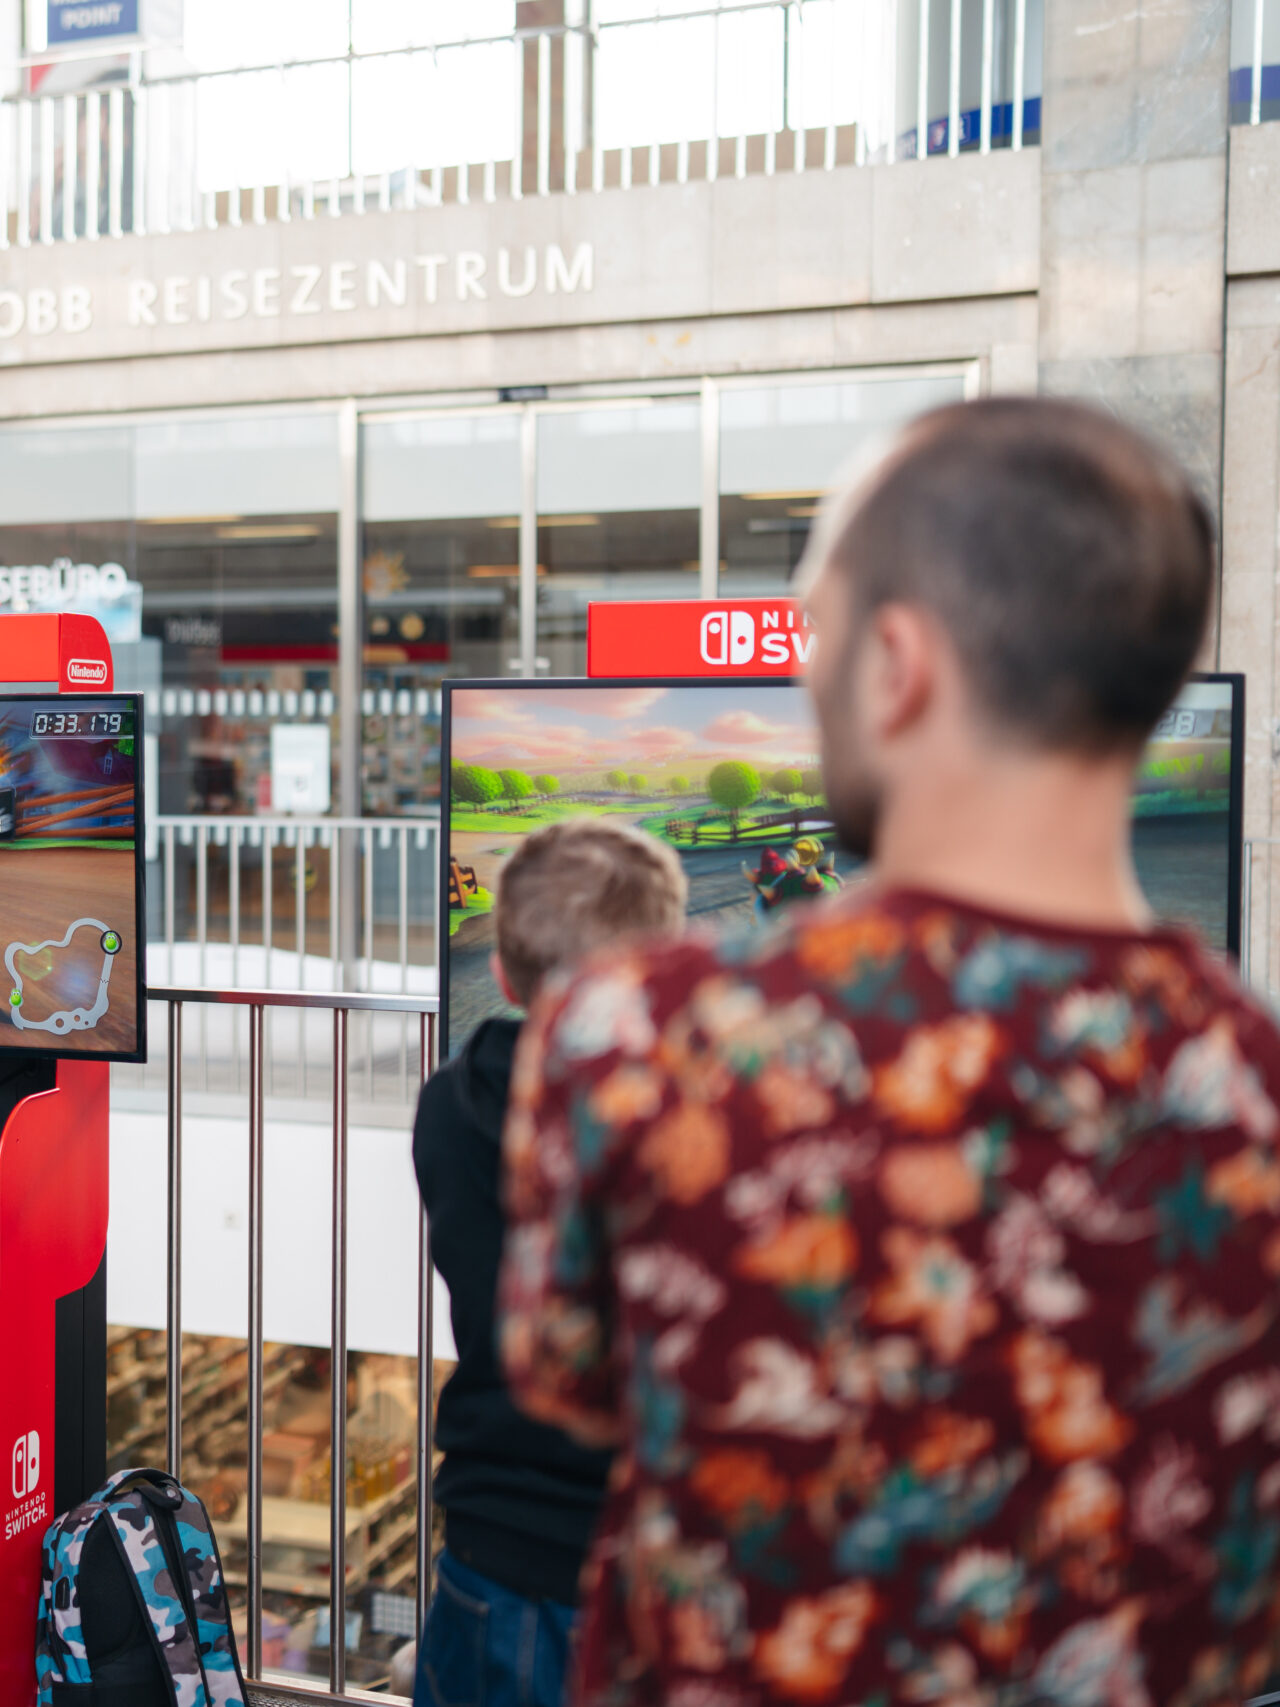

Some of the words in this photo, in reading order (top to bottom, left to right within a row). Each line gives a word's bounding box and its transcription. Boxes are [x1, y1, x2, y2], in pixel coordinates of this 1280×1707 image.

[126, 242, 594, 327] REISEZENTRUM
[71, 664, 104, 679] Nintendo
[5, 1491, 46, 1522] NINTENDO
[5, 1502, 46, 1540] SWITCH
